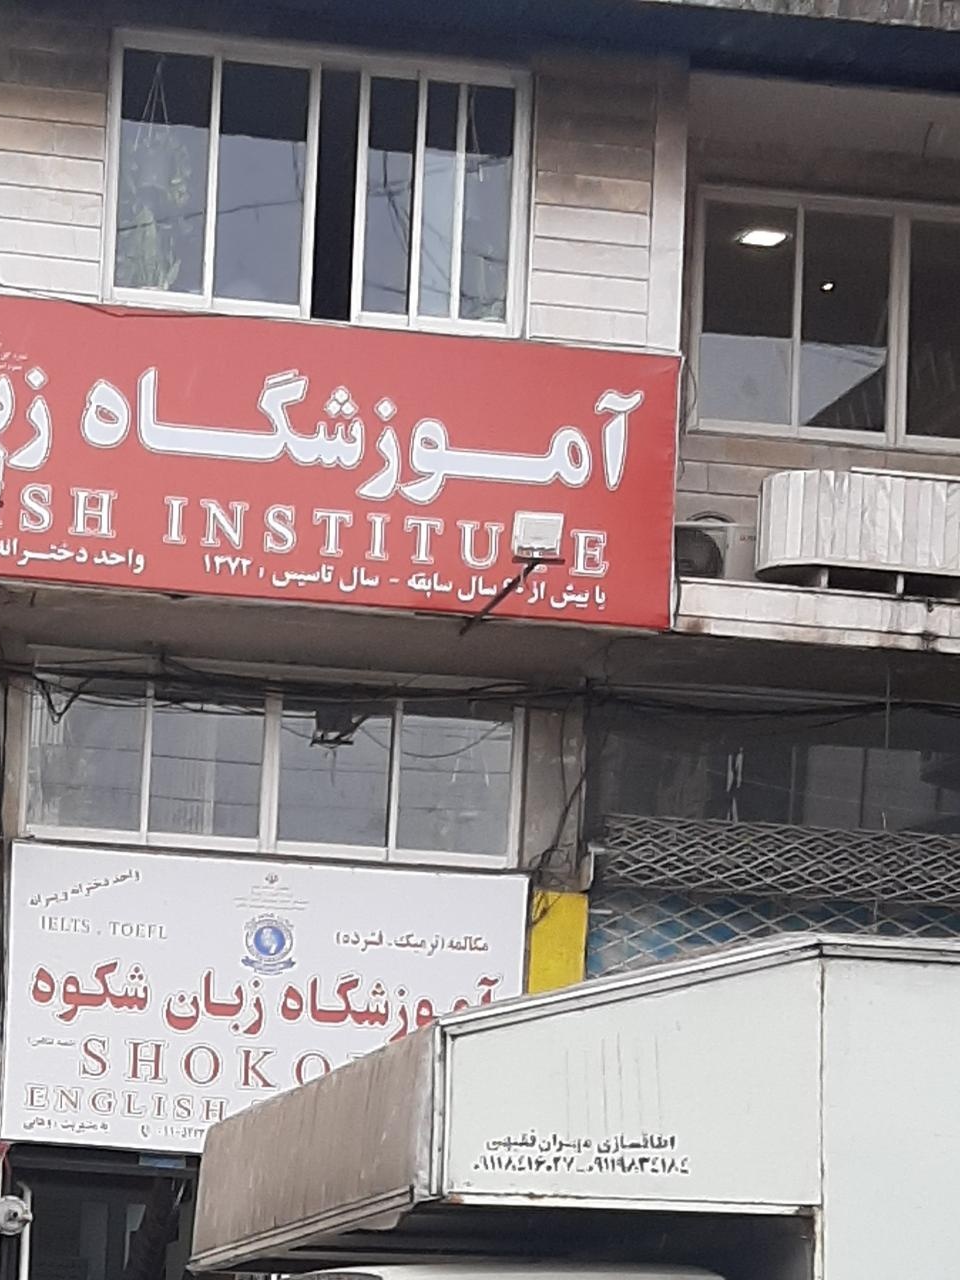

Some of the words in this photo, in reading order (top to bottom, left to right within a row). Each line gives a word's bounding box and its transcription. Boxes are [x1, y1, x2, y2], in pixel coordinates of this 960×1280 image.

[80, 366, 643, 504] آموزشگاه
[162, 496, 610, 578] INSTITUE
[93, 548, 146, 574] واحد
[272, 562, 334, 587] تاسیس
[339, 567, 380, 592] سال
[407, 572, 453, 598] سابقه
[457, 575, 498, 601] سال
[528, 580, 546, 604] از
[550, 583, 590, 609] بیش
[112, 868, 141, 886] واحد
[109, 920, 169, 940] TOEFL
[447, 935, 490, 952] مکالمه
[30, 960, 149, 1023] شکوه
[164, 969, 266, 1038] زبان
[79, 1035, 340, 1090] SHOKO
[24, 1082, 228, 1122] ENGLISH
